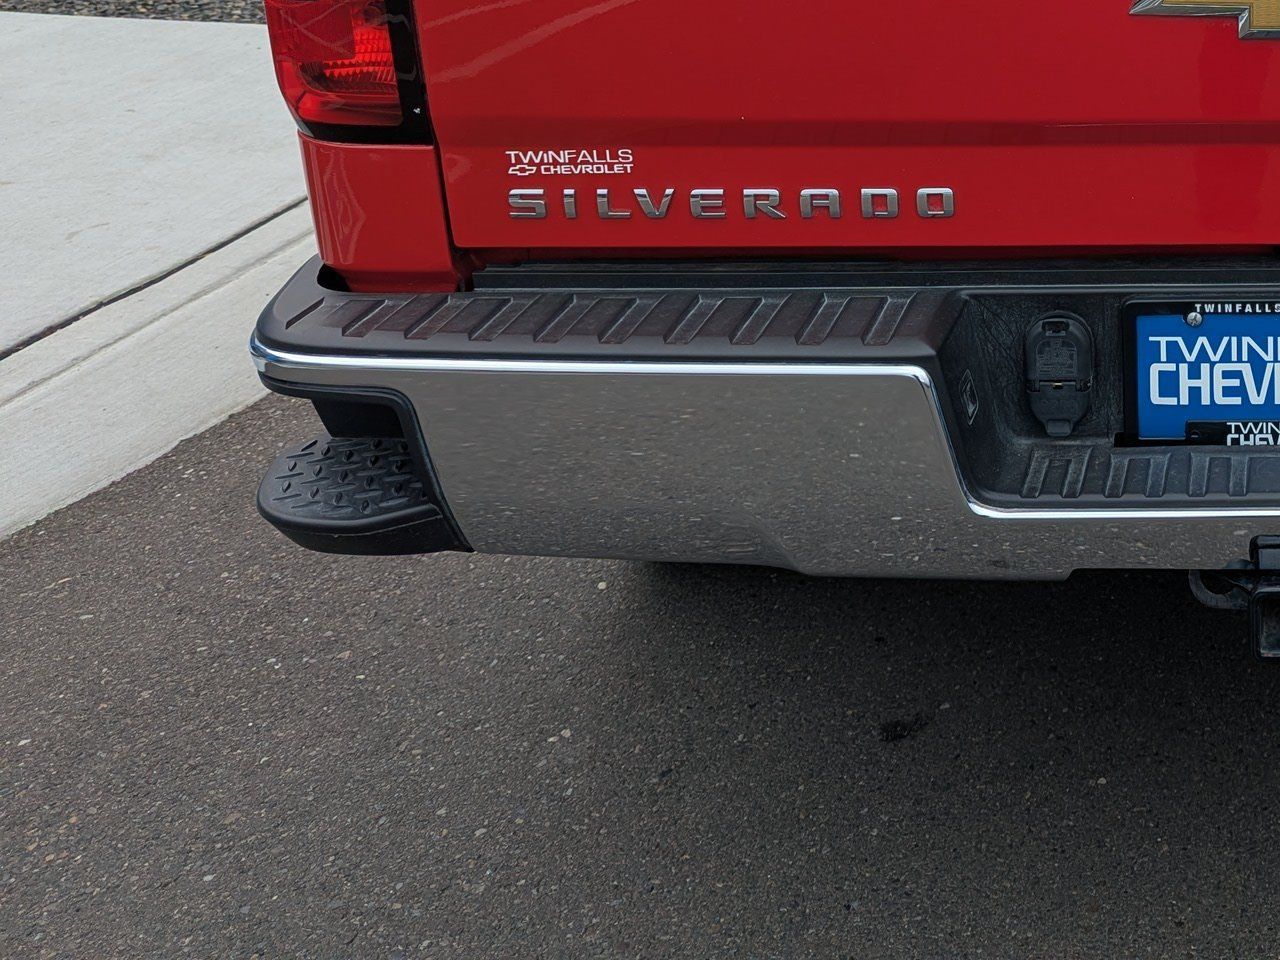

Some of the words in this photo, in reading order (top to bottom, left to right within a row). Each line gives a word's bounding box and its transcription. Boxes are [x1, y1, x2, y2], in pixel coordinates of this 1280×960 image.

[505, 149, 634, 163] TWINFALLS
[540, 163, 634, 175] CHEVROLET
[508, 186, 956, 219] SILVERADO
